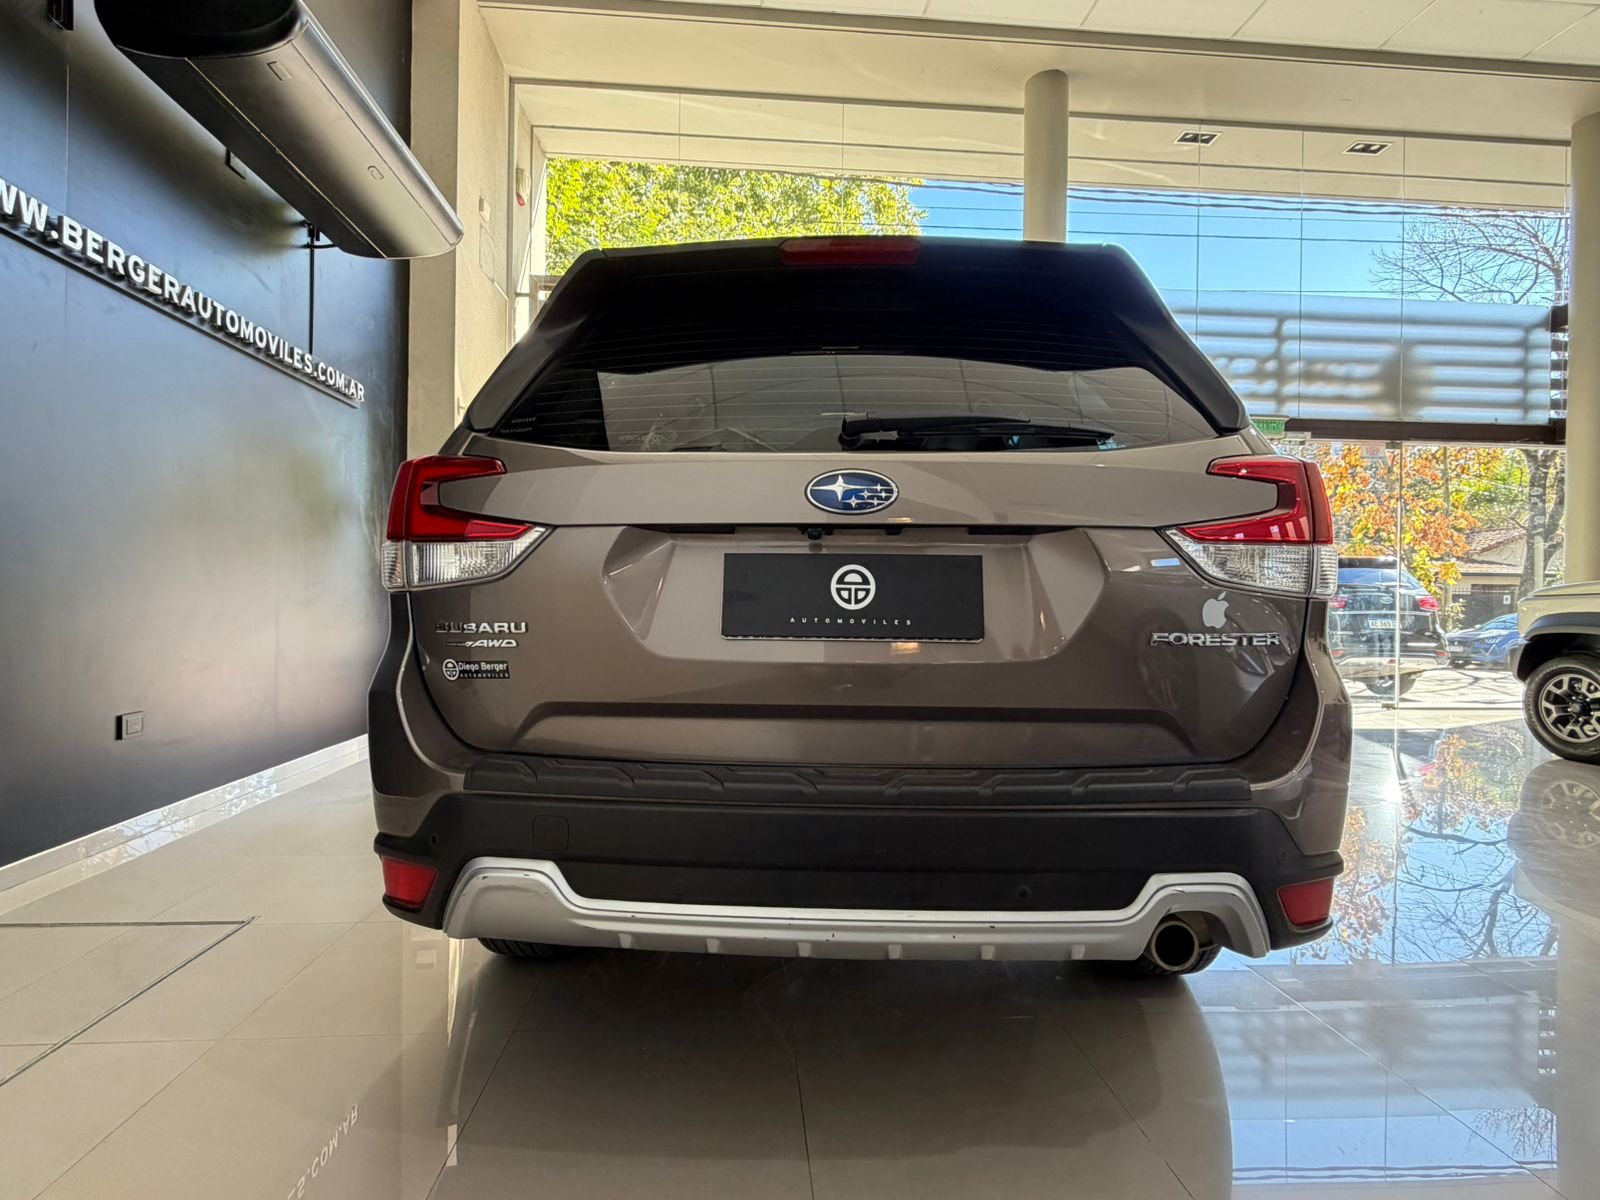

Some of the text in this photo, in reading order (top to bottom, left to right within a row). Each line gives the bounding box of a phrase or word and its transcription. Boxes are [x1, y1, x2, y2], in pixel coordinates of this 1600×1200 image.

[1254, 422, 1283, 433] ALIDA
[790, 617, 912, 626] AUTOMOVILES
[435, 621, 528, 634] SUBARU
[470, 639, 518, 648] AWD
[1150, 632, 1281, 647] FORESTER
[458, 662, 508, 672] Diego Berger
